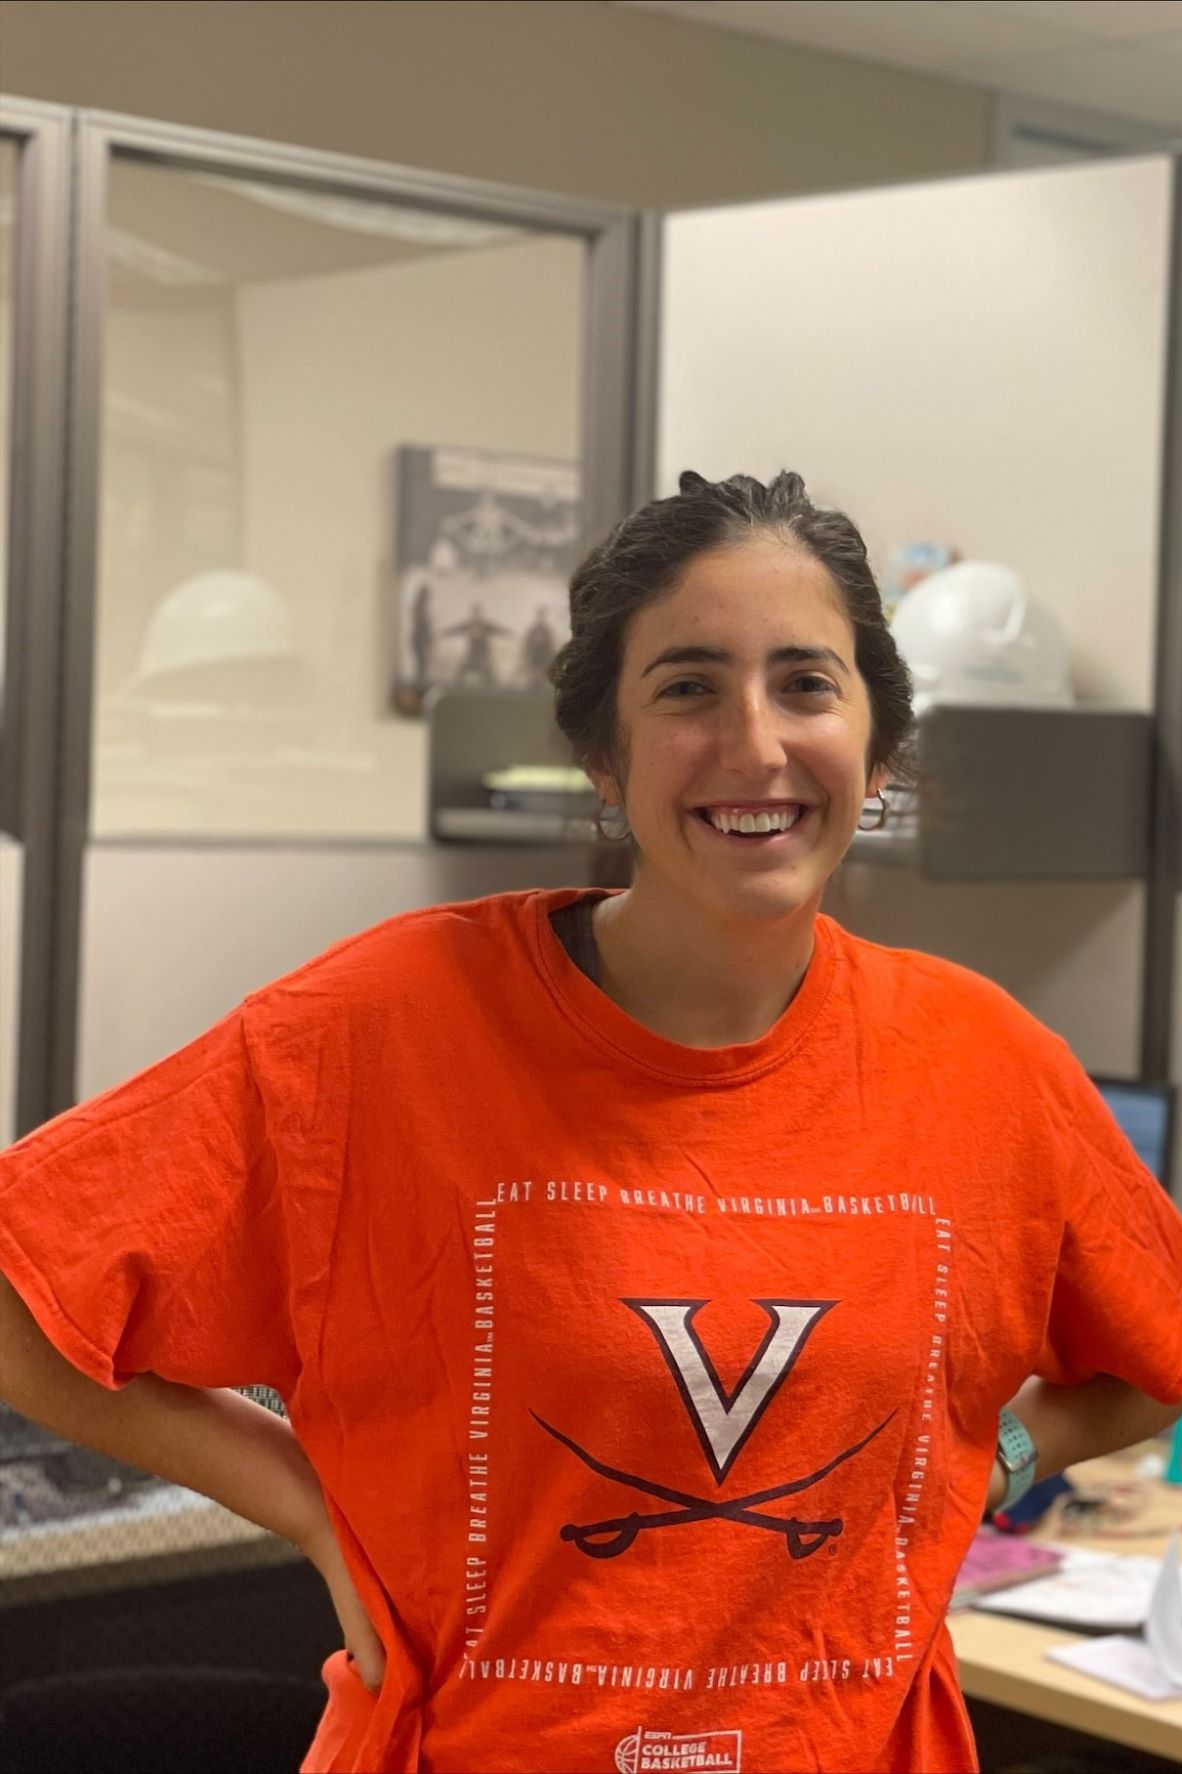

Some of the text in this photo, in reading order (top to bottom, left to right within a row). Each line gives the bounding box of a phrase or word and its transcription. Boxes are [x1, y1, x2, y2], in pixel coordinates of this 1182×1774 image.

[497, 1181, 532, 1202] EAT
[546, 1181, 608, 1202] SLEEP
[620, 1188, 706, 1214] BREATHE
[935, 1218, 952, 1252] EAT
[473, 1197, 497, 1329] BASKETBALL
[934, 1264, 949, 1323] SLEEP
[618, 1297, 841, 1486] V
[468, 1453, 489, 1543] BREATHE
[466, 1556, 487, 1616] SLEEP
[463, 1626, 486, 1659] AT
[706, 1661, 787, 1689] BREATHE
[800, 1659, 851, 1682] SLEEP
[863, 1657, 893, 1678] EAT
[642, 1741, 706, 1757] COLLEGE
[644, 1731, 672, 1740] ESPN
[640, 1753, 733, 1770] BASKETBALL
